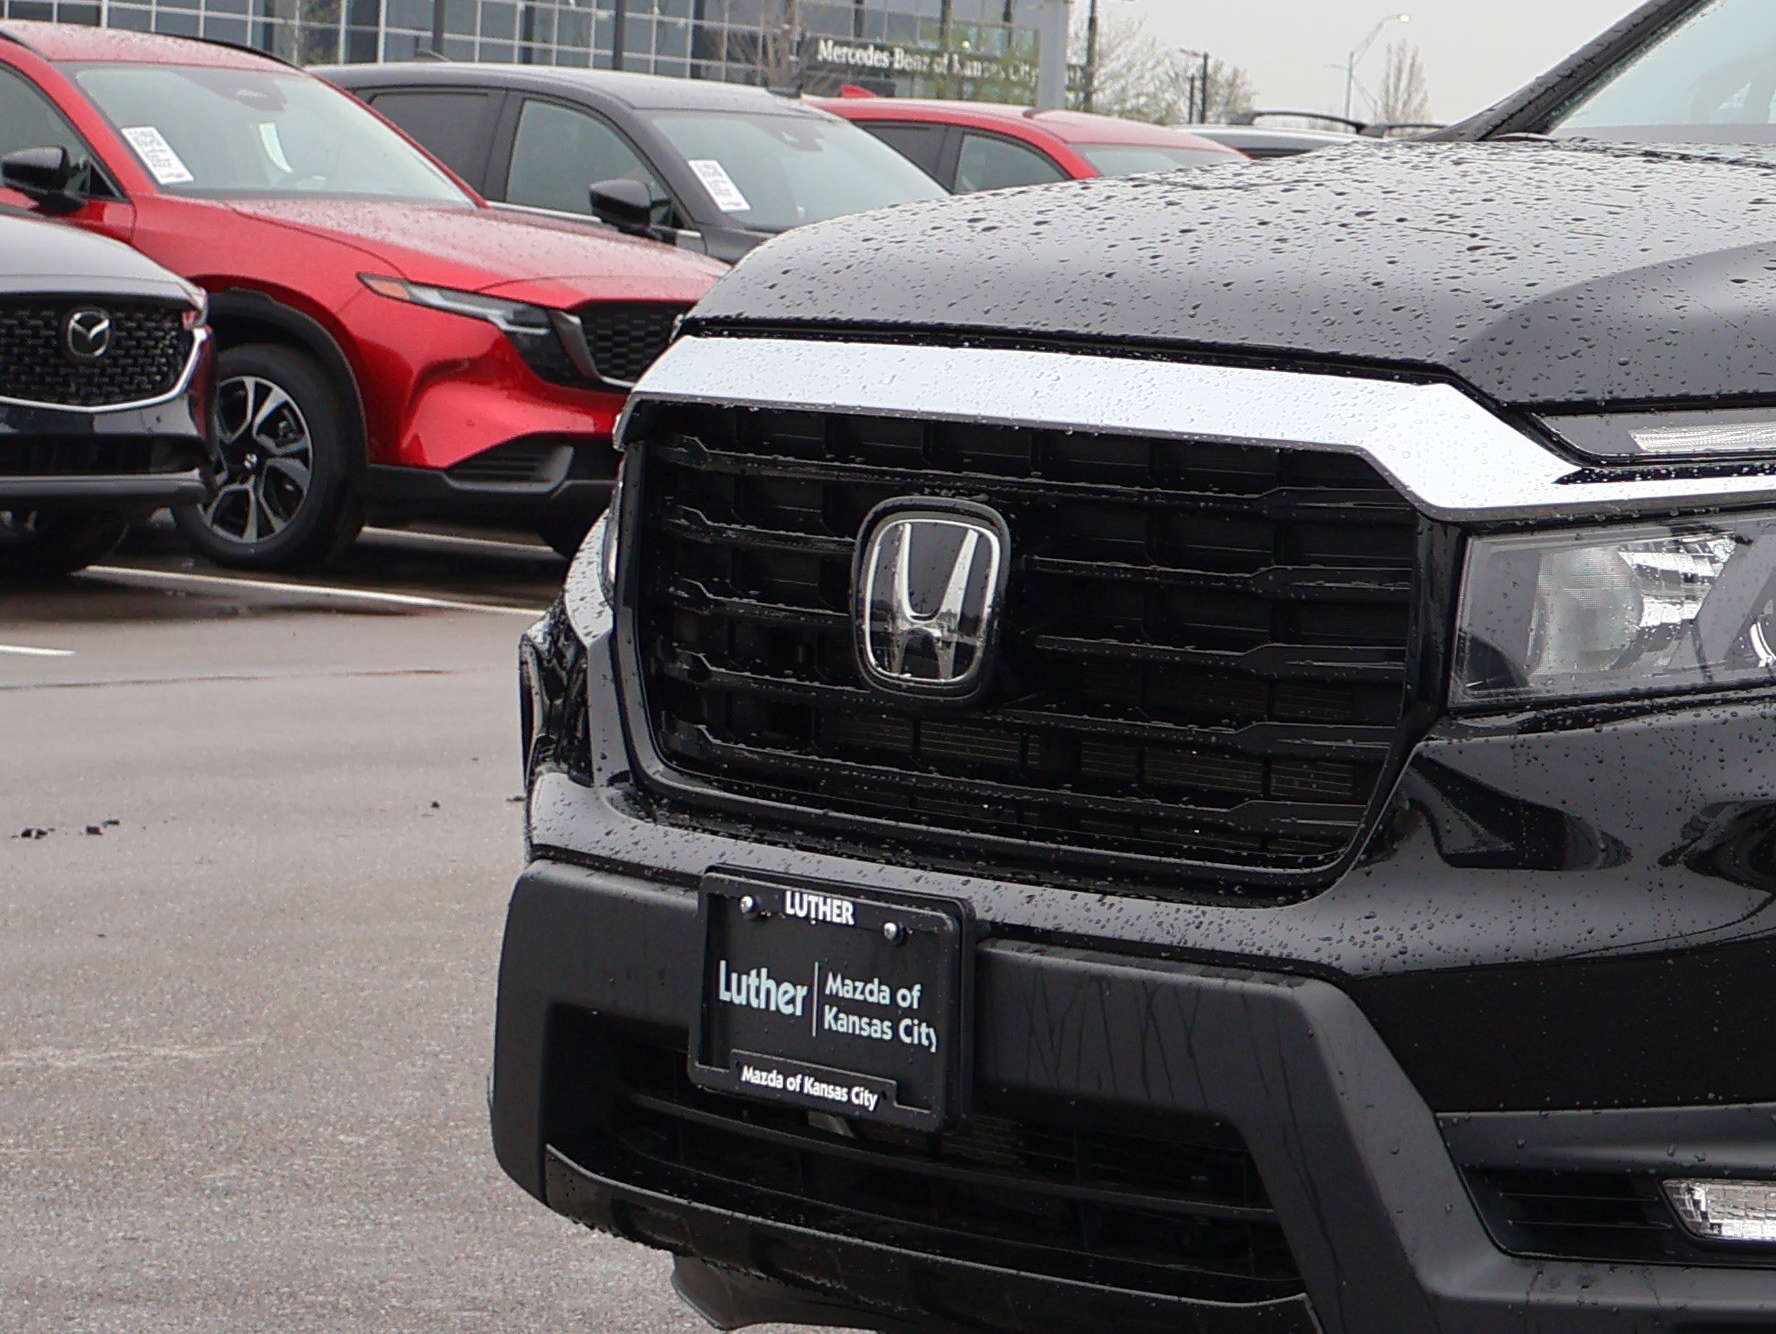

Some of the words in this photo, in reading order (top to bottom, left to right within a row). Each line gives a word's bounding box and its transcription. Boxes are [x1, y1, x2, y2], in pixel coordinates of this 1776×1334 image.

[816, 38, 931, 73] Mercedes-Benz
[933, 51, 949, 75] of
[784, 890, 855, 926] LUTHER
[718, 959, 809, 1017] Luther
[824, 971, 891, 1006] Mazda
[895, 984, 922, 1010] of
[823, 1004, 893, 1042] Kansas
[898, 1018, 938, 1053] City
[740, 1064, 785, 1089] Mazda
[786, 1074, 803, 1092] of
[803, 1076, 849, 1102] Kansas
[850, 1086, 880, 1112] City
